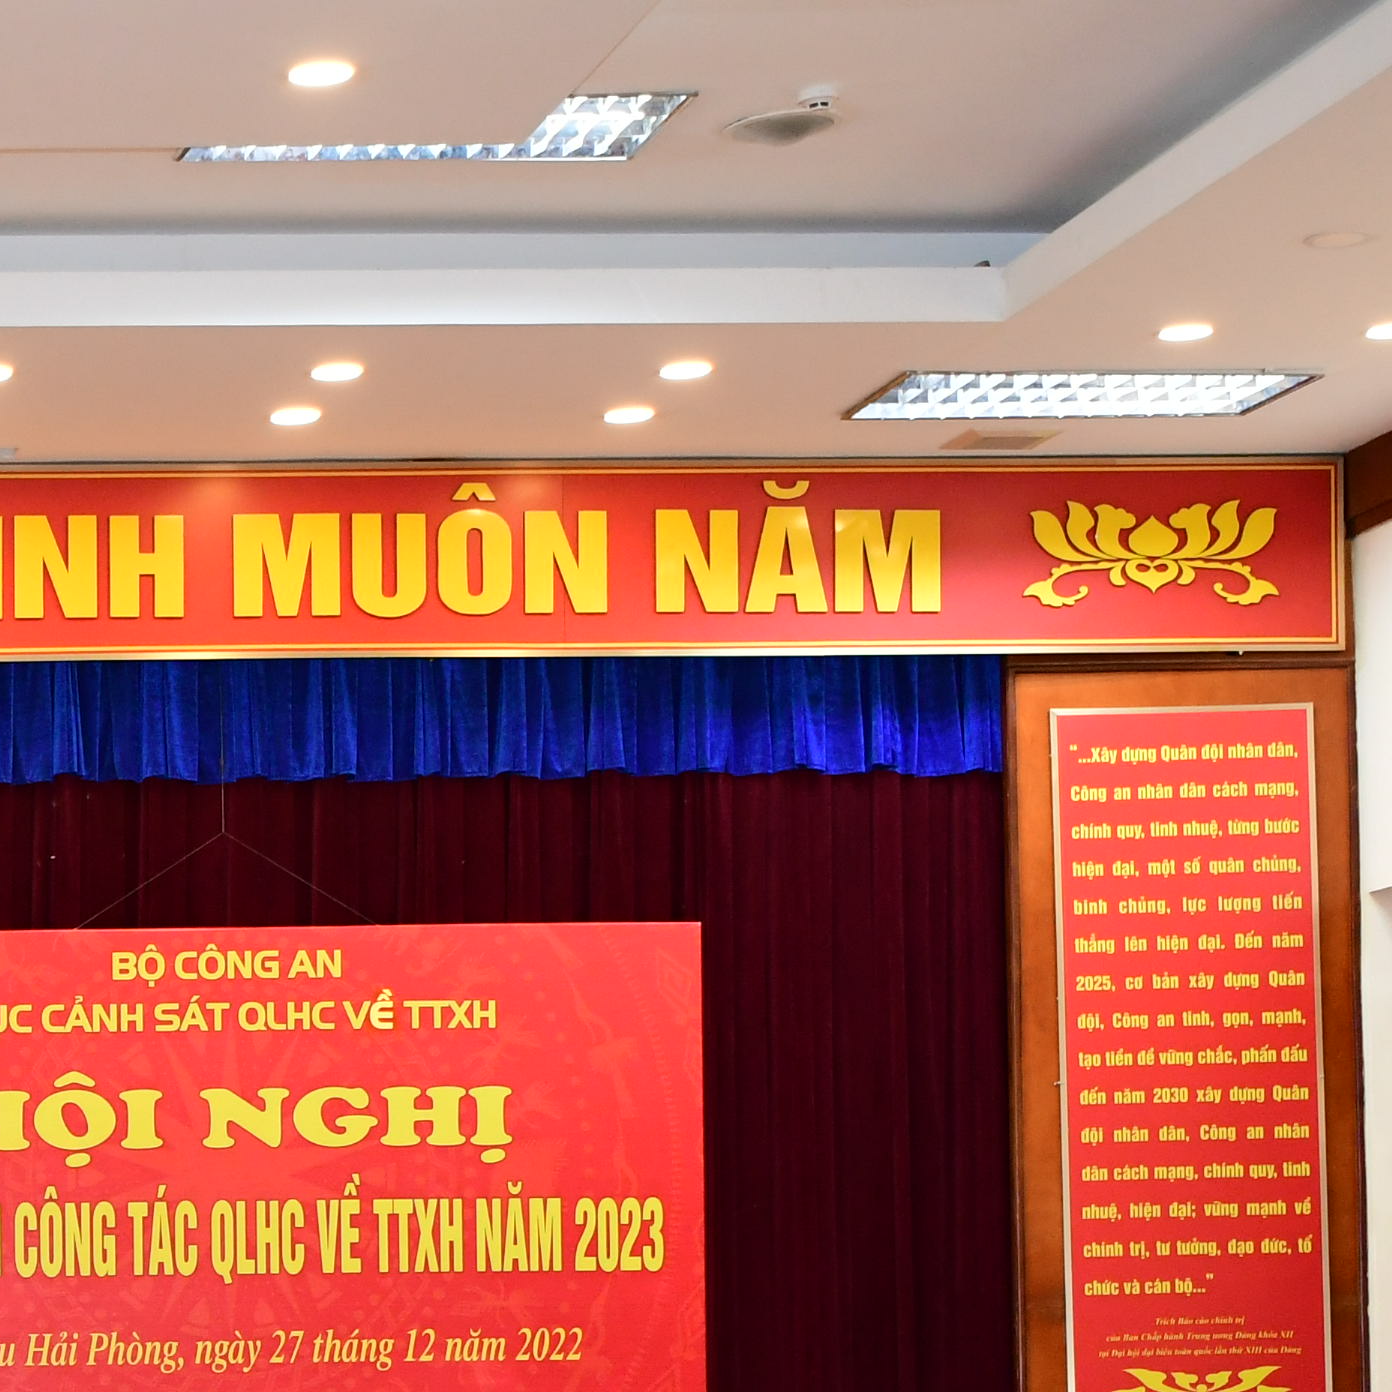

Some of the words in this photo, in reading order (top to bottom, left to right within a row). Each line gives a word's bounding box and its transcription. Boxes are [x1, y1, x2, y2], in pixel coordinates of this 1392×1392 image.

[232, 482, 608, 617] MUÔN
[655, 479, 941, 613] NĂM
[1121, 747, 1157, 765] dựng
[1161, 744, 1197, 762] Quân
[1201, 744, 1223, 762] đội
[1228, 743, 1263, 758] nhân
[1267, 742, 1298, 758] dân,
[1071, 785, 1107, 802] Công
[1114, 787, 1131, 800] an
[1138, 784, 1173, 799] nhân
[1180, 782, 1206, 798] dân
[1213, 781, 1248, 797] cách
[1255, 782, 1298, 798] mạng,
[112, 944, 165, 987] BỘ
[175, 944, 279, 980] CÔNG
[288, 949, 341, 978] AN
[1076, 975, 1115, 992] 2025,
[1125, 976, 1143, 990] cơ
[1152, 972, 1179, 989] bản
[1189, 972, 1214, 989] xây
[1224, 972, 1259, 990] dựng
[1269, 970, 1305, 987] Quân
[42, 995, 143, 1032] CẢNH
[154, 995, 230, 1031] SÁT
[238, 1001, 335, 1031] QLHC
[342, 989, 394, 1029] VỀ
[403, 1000, 496, 1029] TTXH
[1080, 1087, 1106, 1105] đến
[1114, 1088, 1145, 1104] năm
[1153, 1087, 1188, 1103] 2030
[1196, 1086, 1222, 1103] xây
[1230, 1086, 1265, 1104] dựng
[1273, 1085, 1309, 1102] Quân
[200, 1086, 512, 1163] NGHỊ
[15, 1186, 116, 1278] CÔNG
[128, 1185, 198, 1276] TÁC
[211, 1199, 305, 1284] QLHC
[317, 1173, 361, 1273] VỀ
[373, 1198, 463, 1272] TTXH
[476, 1181, 562, 1272] NĂM
[575, 1197, 664, 1272] 2023
[1084, 1280, 1119, 1296] chức
[1123, 1279, 1140, 1294] và
[1145, 1278, 1171, 1294] cán
[24, 1331, 79, 1366] Hải
[86, 1331, 184, 1374] Phòng,
[195, 1330, 261, 1373] ngày
[269, 1330, 304, 1363] 27
[313, 1329, 395, 1371] tháng
[404, 1328, 435, 1362] 12
[445, 1328, 506, 1362] năm
[515, 1327, 582, 1361] 2022
